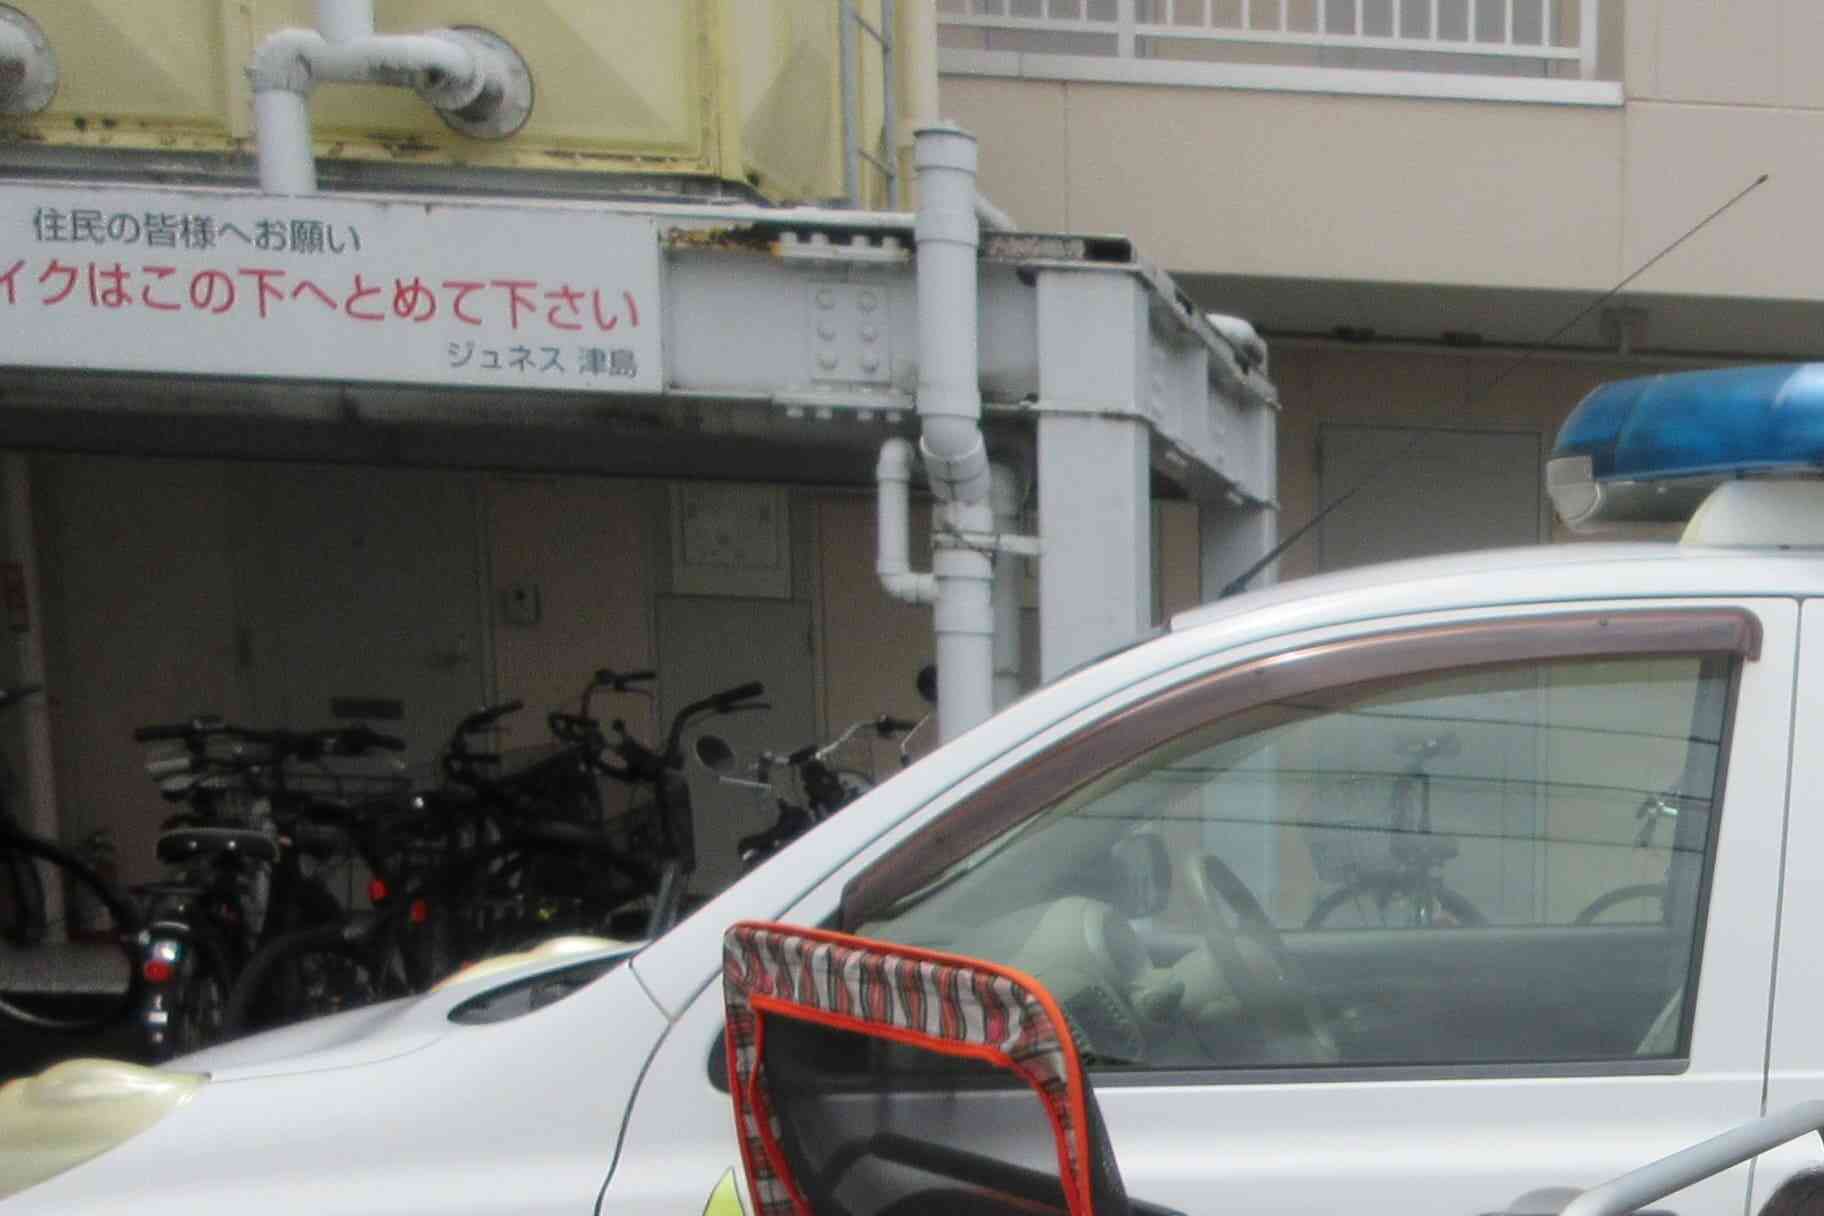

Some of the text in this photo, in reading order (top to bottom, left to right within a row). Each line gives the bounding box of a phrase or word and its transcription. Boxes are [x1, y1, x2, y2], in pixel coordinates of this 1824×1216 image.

[33, 207, 361, 255] 住民の皆様へお願い
[448, 341, 638, 378] ジュネス 津島
